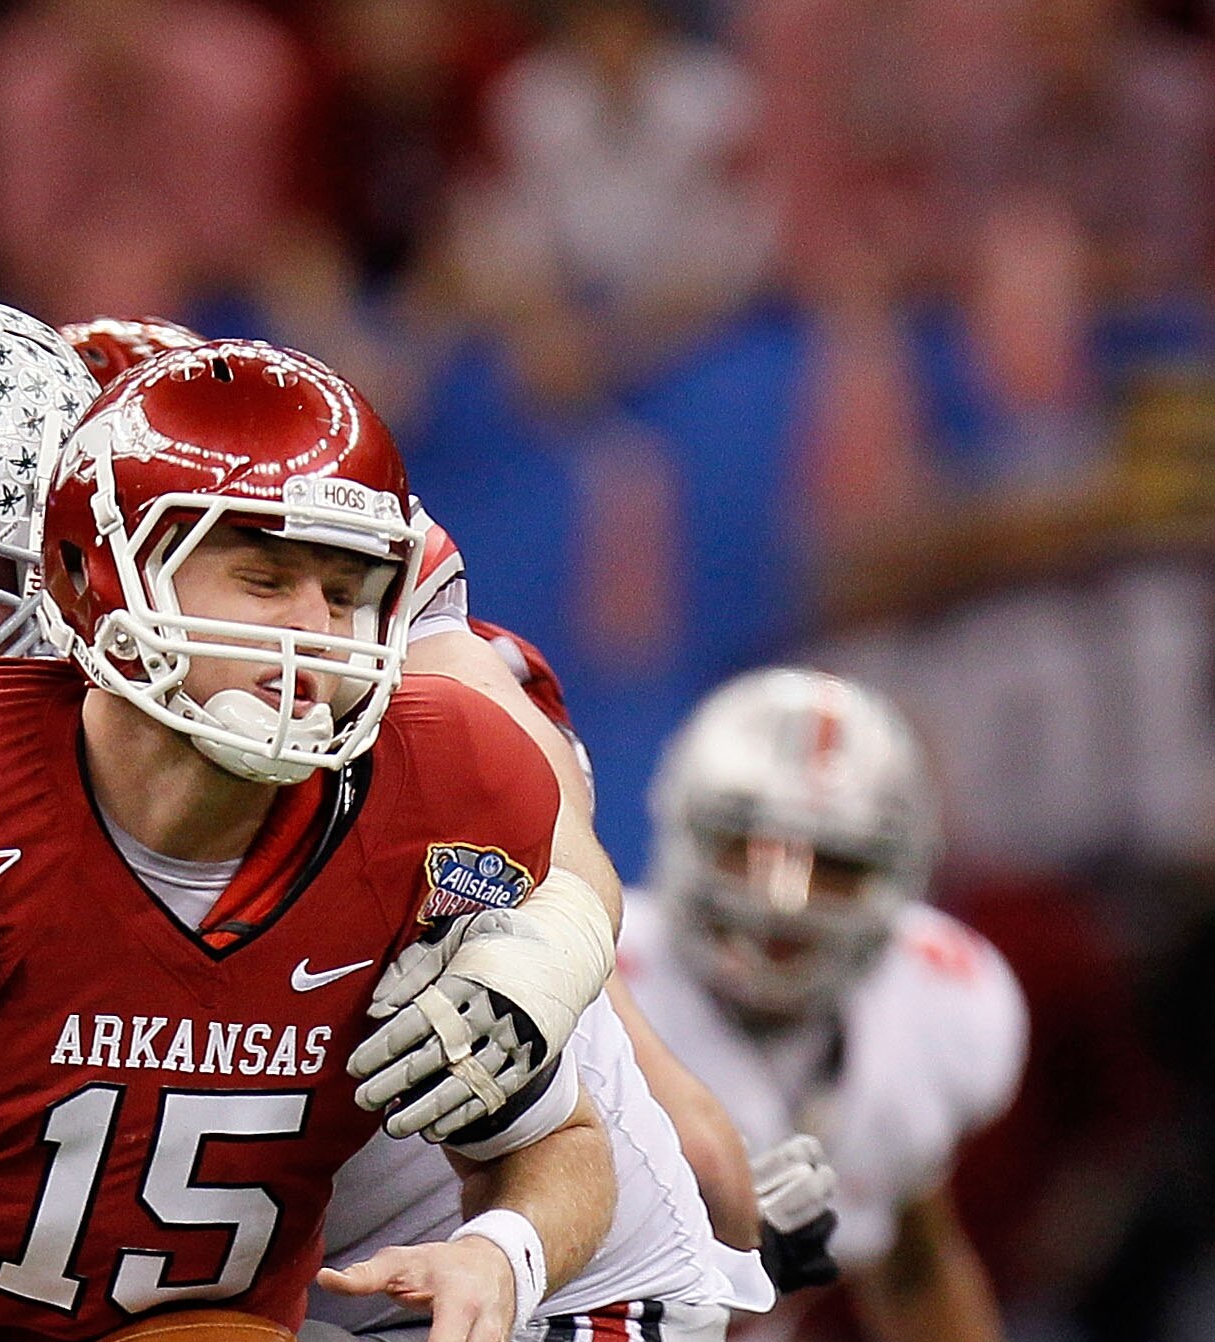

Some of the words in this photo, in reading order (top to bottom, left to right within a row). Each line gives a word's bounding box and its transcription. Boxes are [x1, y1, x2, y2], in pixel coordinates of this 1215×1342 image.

[325, 484, 366, 510] HOGS
[440, 866, 512, 907] Allstate
[50, 1014, 332, 1076] ARKANSAS
